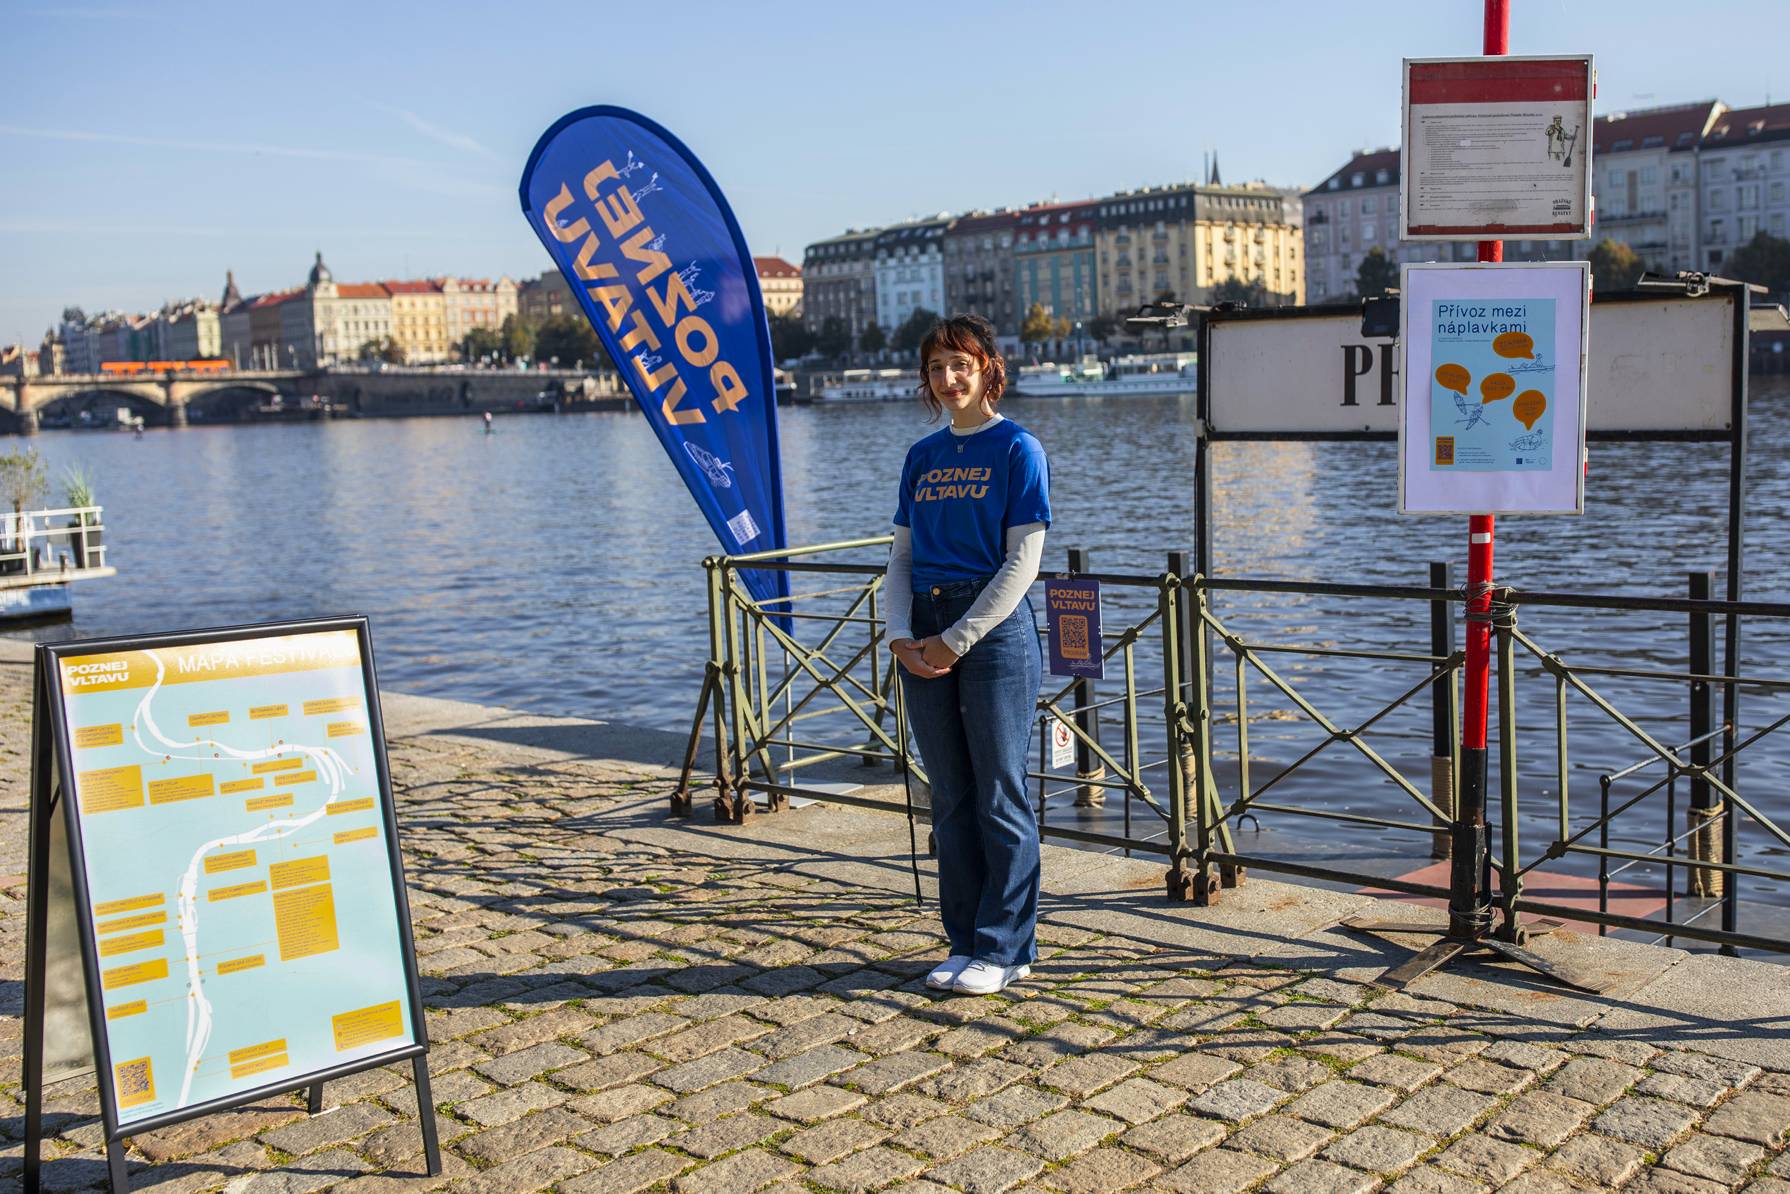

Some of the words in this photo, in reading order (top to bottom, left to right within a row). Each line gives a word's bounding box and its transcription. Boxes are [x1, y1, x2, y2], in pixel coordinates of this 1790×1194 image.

[1438, 304, 1486, 318] Přívoz
[1492, 305, 1526, 318] mezi
[1438, 320, 1526, 334] náplavkami
[917, 467, 992, 486] POZNEJ
[915, 484, 990, 502] VLTAVU
[1049, 588, 1095, 600] POZNEJ
[1051, 599, 1096, 611] VLTAVU
[178, 654, 240, 673] MAPA
[246, 645, 356, 667] FESTIVA
[66, 661, 128, 675] POZNEJ
[69, 672, 129, 686] VLTAVU
